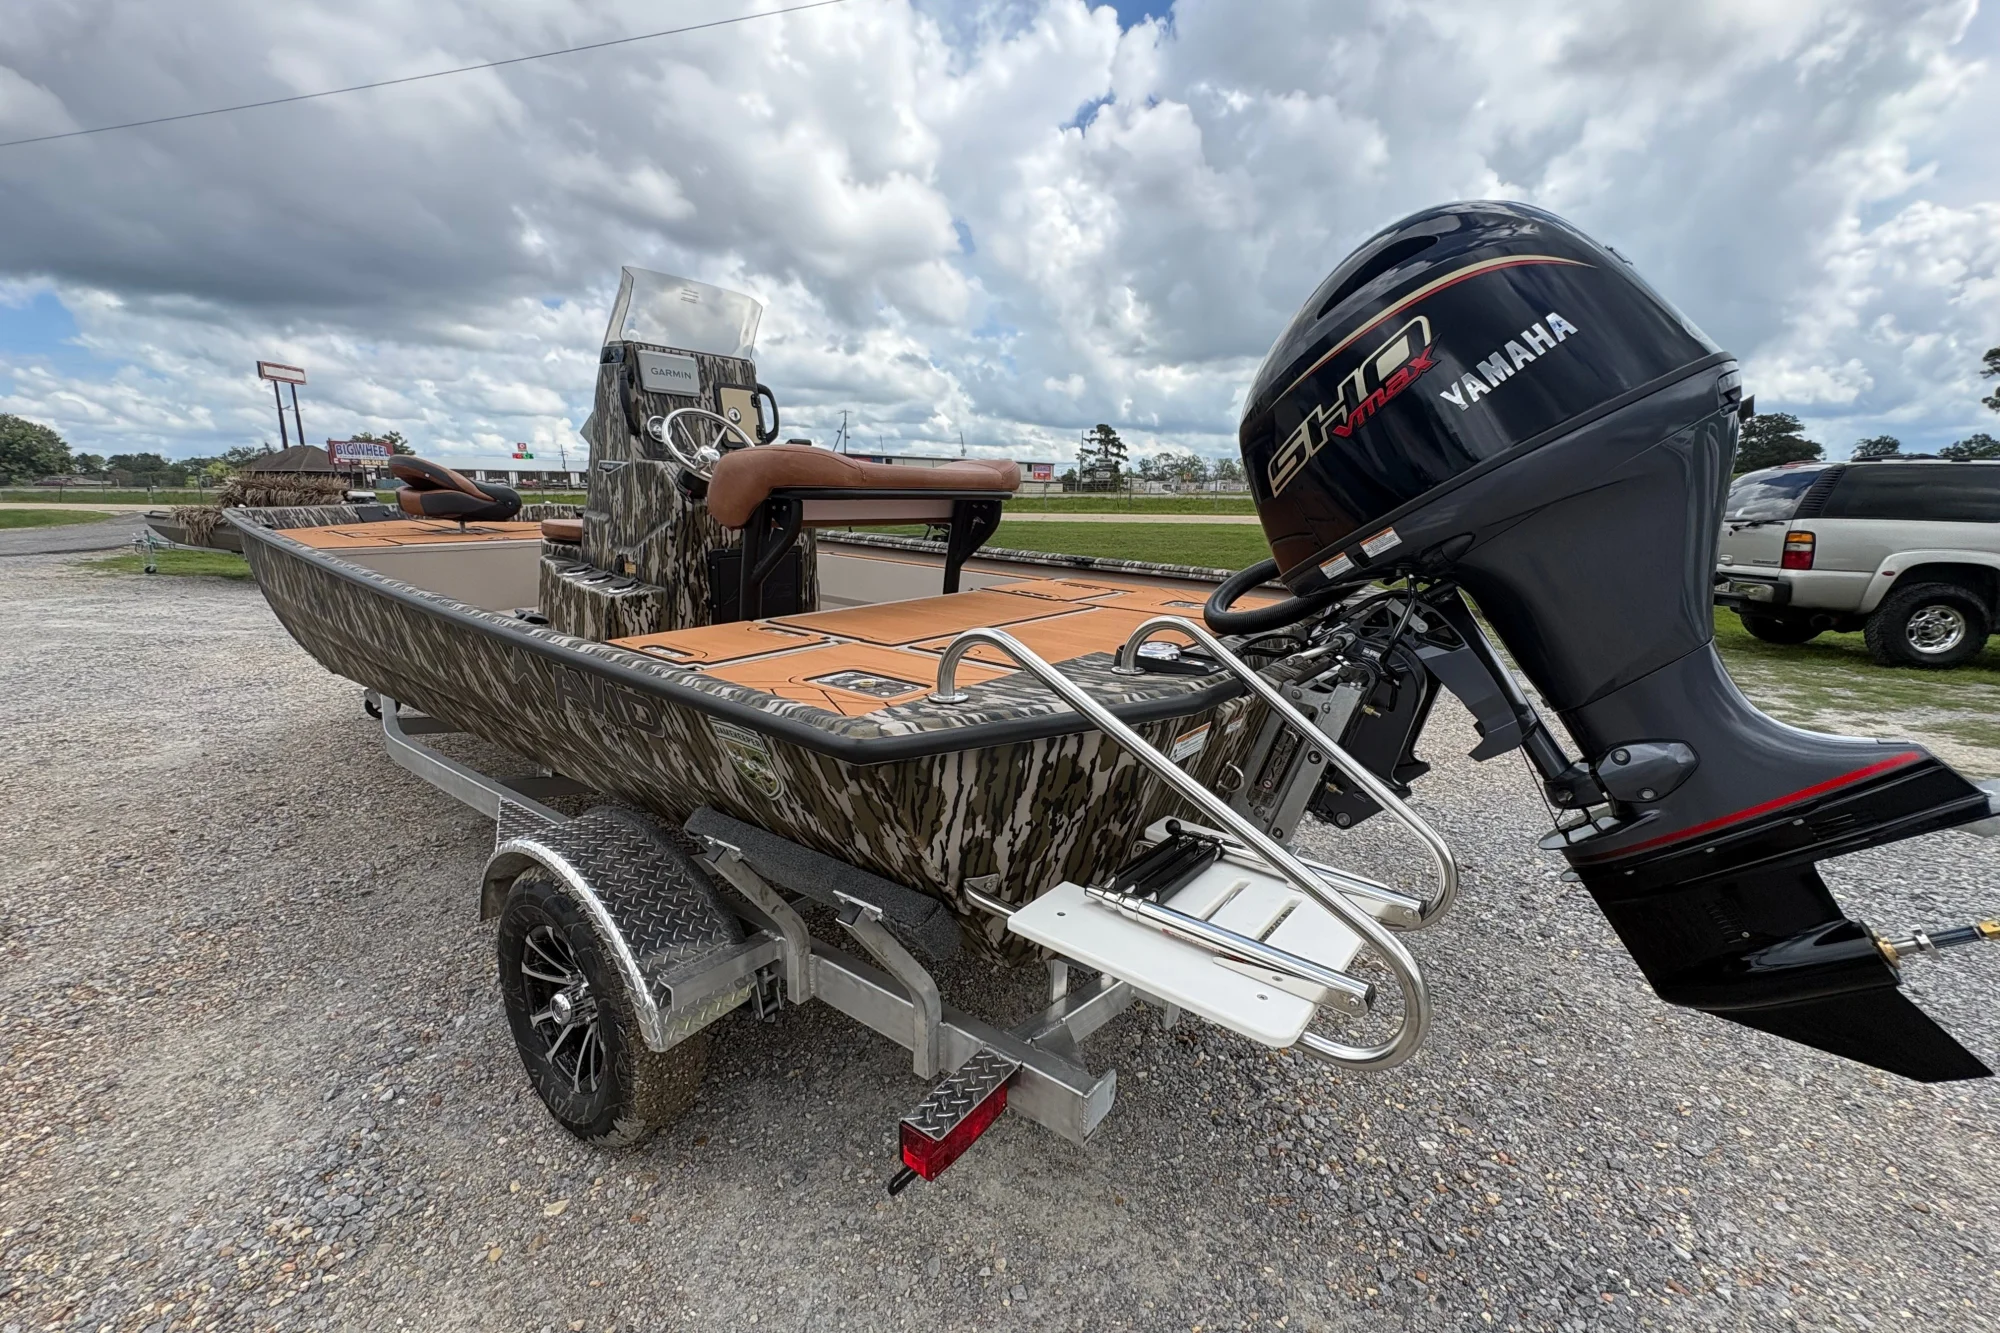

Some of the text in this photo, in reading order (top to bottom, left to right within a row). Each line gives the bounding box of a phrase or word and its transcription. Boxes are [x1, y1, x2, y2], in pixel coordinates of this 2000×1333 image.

[650, 366, 692, 380] GARMIN
[1439, 312, 1579, 412] YAMAHA
[335, 443, 355, 455] BIG
[354, 443, 390, 457] WHEEL
[552, 664, 666, 738] AVID
